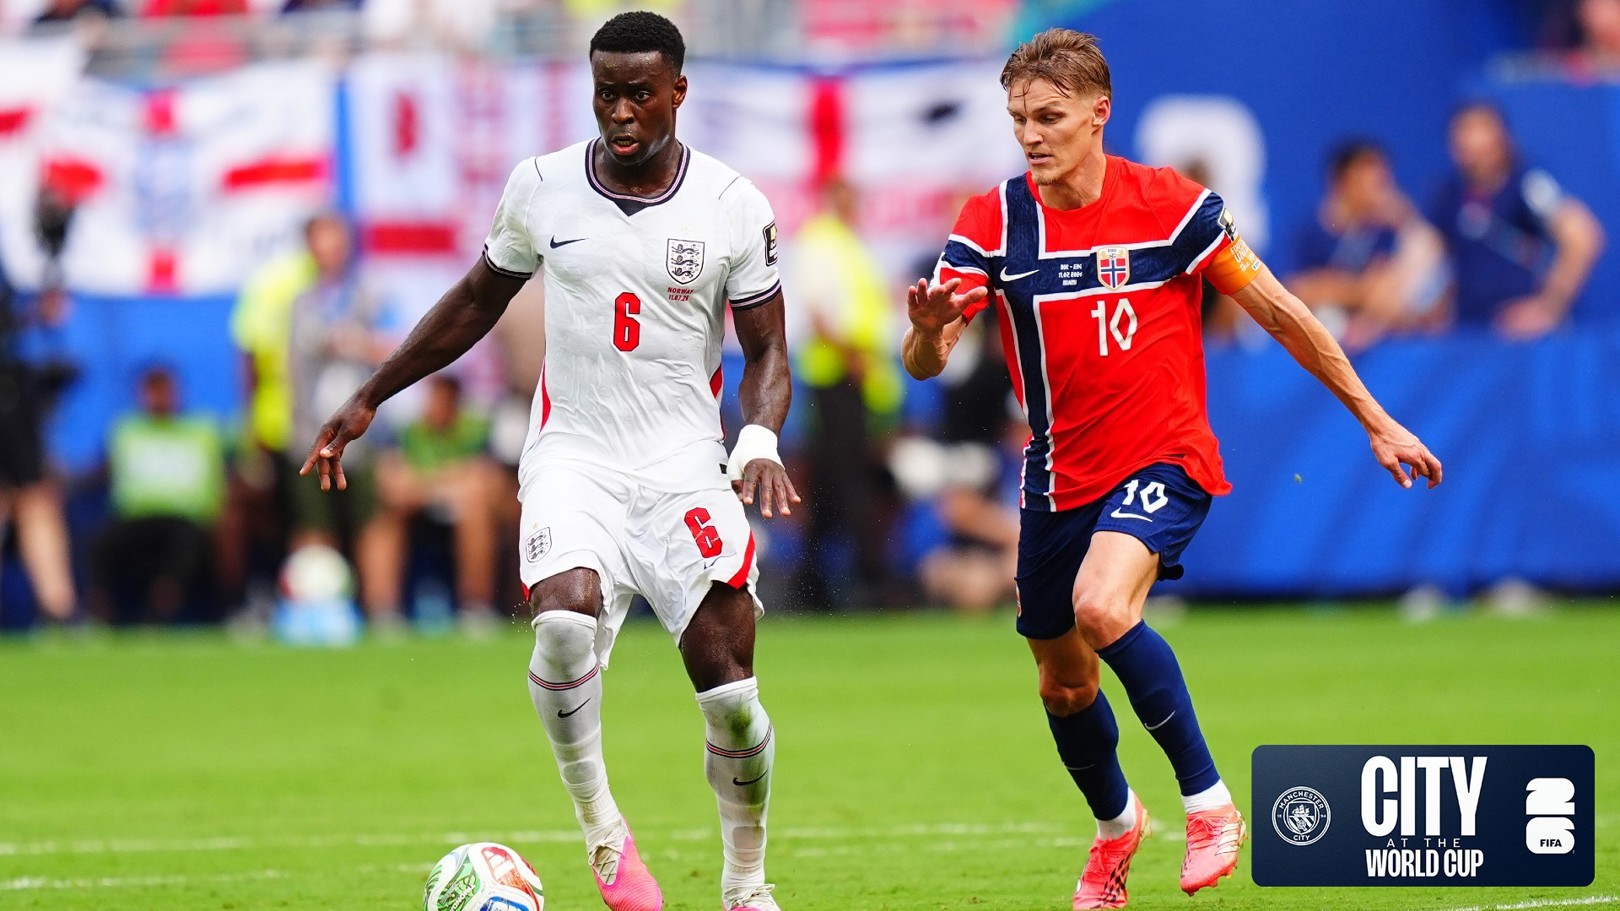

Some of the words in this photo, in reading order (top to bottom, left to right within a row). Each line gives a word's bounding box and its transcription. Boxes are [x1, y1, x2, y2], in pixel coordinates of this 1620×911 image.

[667, 286, 695, 294] NORWAY
[613, 292, 641, 352] 6
[1091, 298, 1138, 356] 10
[1122, 479, 1168, 513] 10
[684, 507, 723, 558] 6
